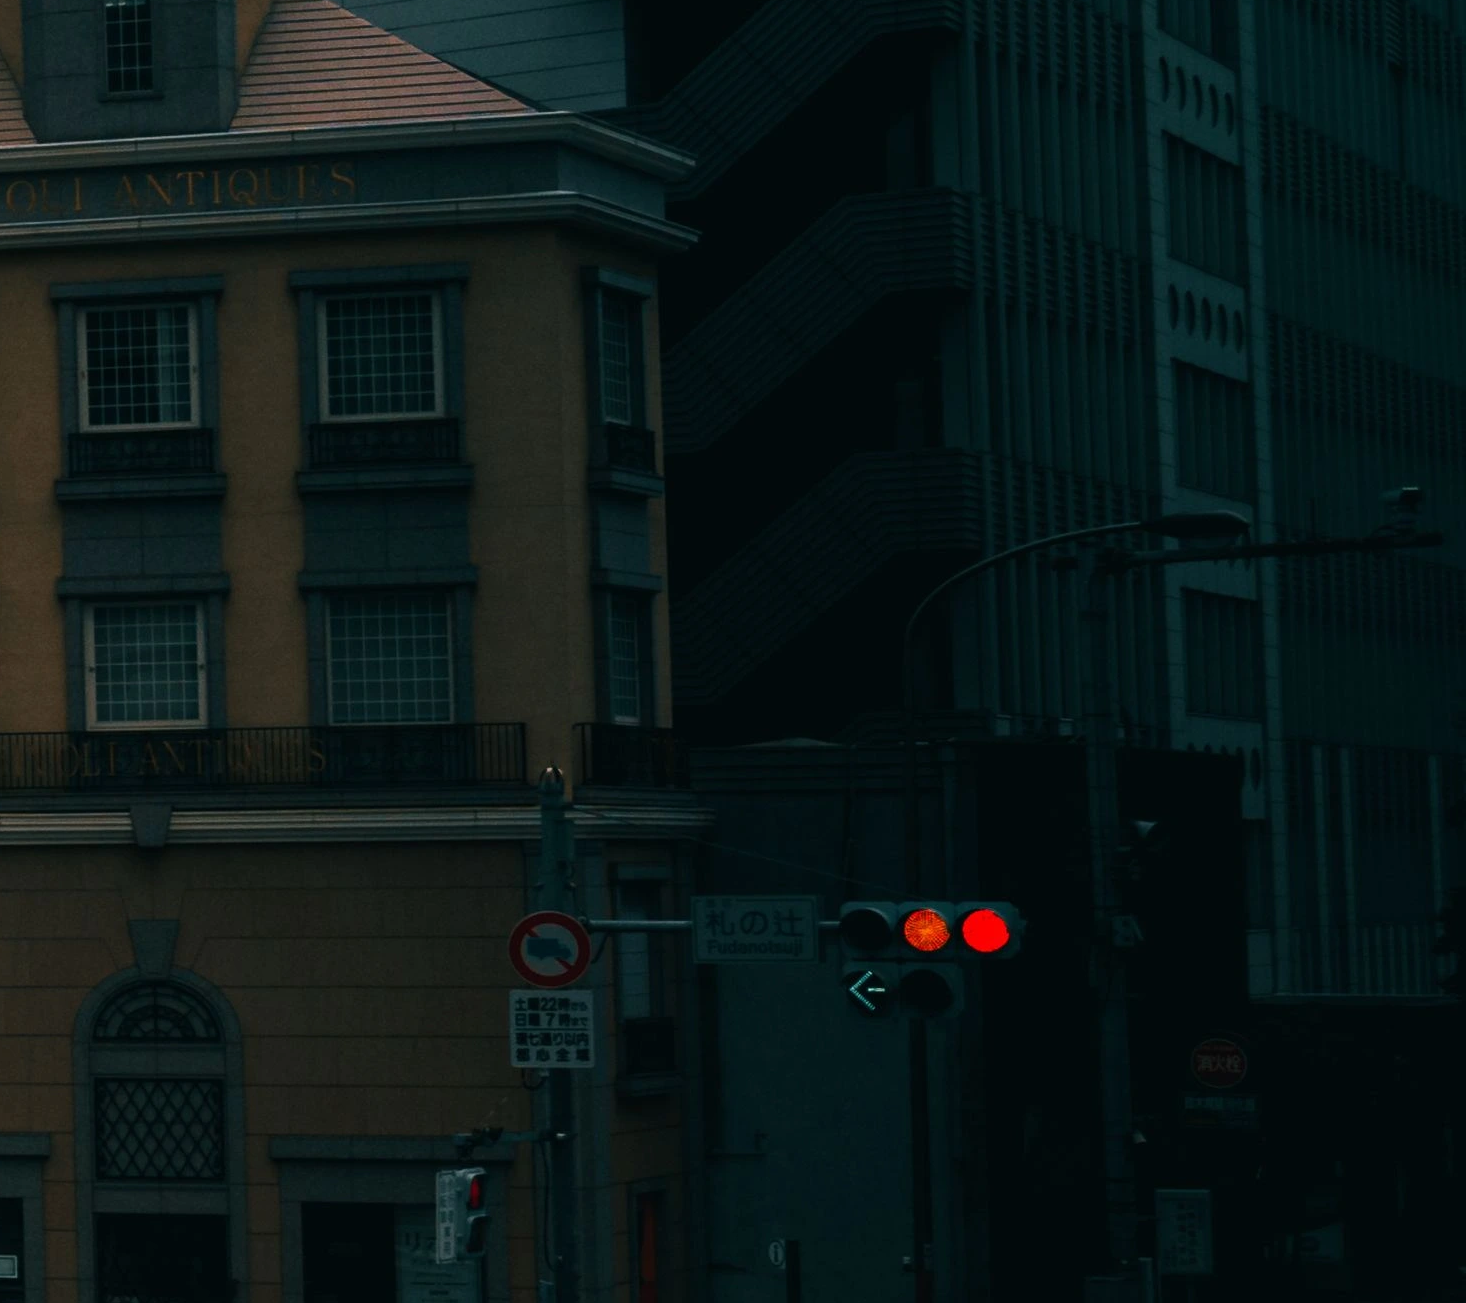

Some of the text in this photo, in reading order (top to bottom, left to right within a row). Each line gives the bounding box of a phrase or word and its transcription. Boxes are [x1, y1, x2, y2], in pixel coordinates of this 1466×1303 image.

[114, 160, 358, 208] ANTIQUES
[705, 908, 805, 937] 札の辻
